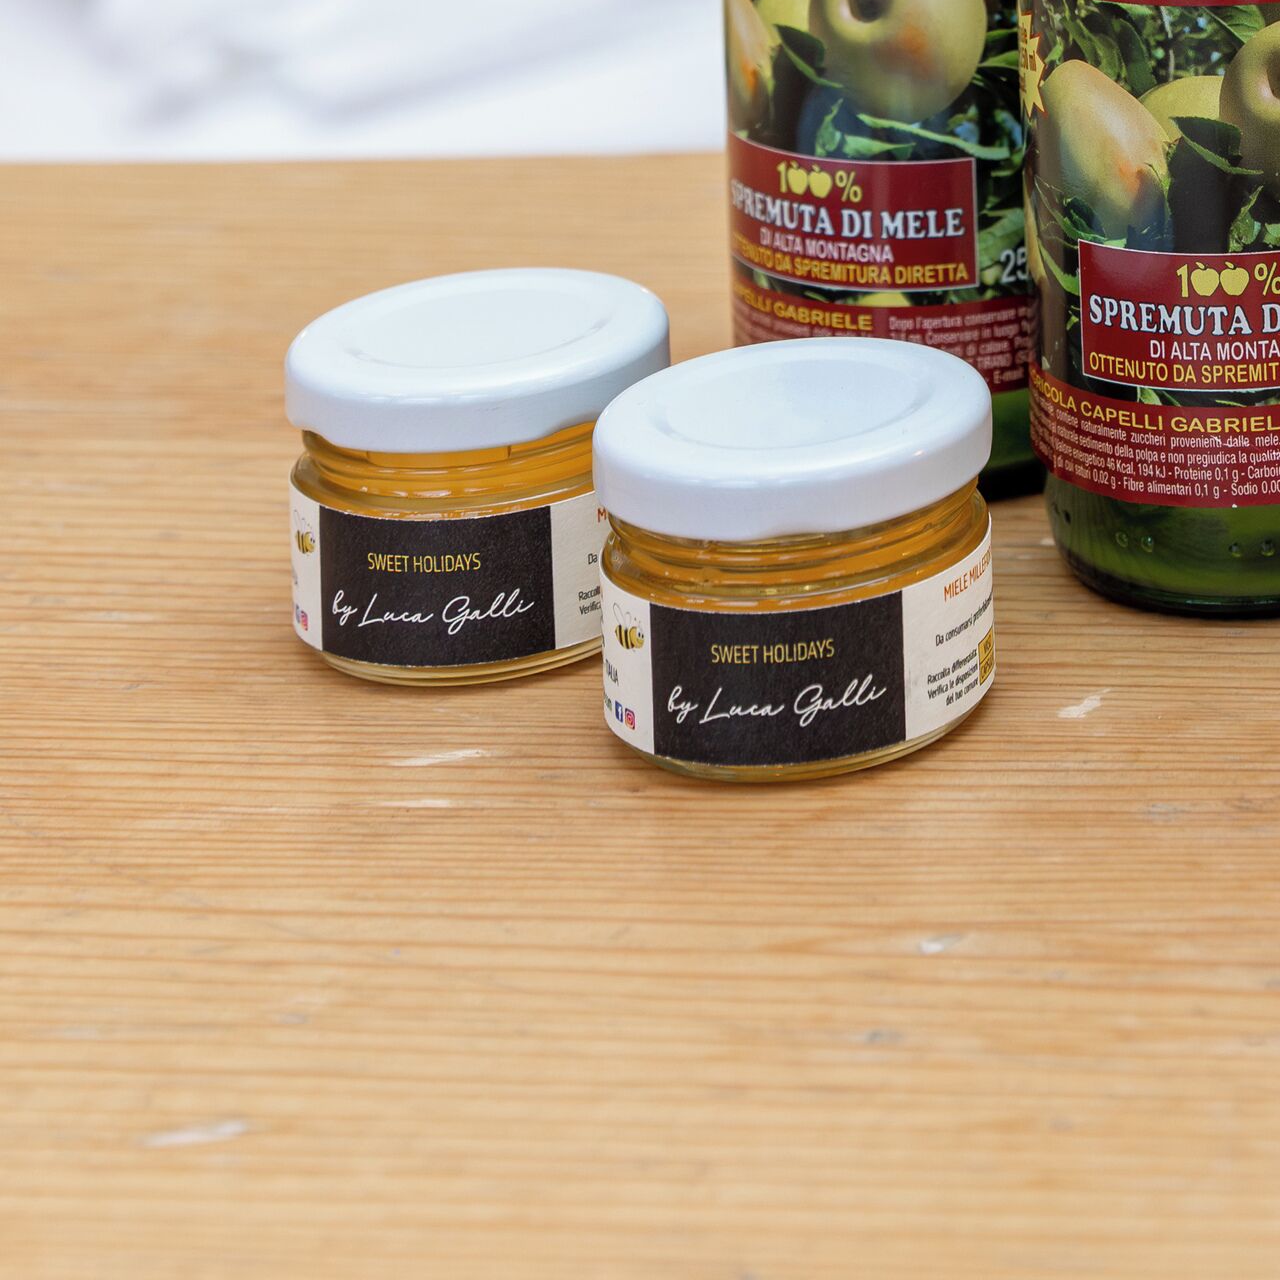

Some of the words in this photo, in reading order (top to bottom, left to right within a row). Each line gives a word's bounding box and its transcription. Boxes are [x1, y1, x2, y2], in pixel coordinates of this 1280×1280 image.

[731, 178, 835, 237] SPREMUTA
[840, 208, 874, 239] DI
[880, 207, 966, 240] MELE
[772, 229, 803, 256] ALTA
[804, 236, 894, 264] MONTAGNA
[774, 251, 793, 274] DA
[794, 255, 890, 285] SPREMITURA
[894, 262, 969, 285] DIRETTA
[773, 300, 873, 331] GABRIELE
[1089, 294, 1253, 336] SPREMUTA
[1150, 339, 1166, 360] DI
[1170, 340, 1212, 361] ALTA
[1089, 351, 1168, 382] OTTENUTO
[1173, 363, 1197, 383] DA
[1080, 401, 1164, 431] CAPELLI
[1081, 419, 1127, 441] naturalmente
[1130, 431, 1166, 447] zuccheri
[1170, 433, 1222, 449] provenienti
[1226, 434, 1250, 448] dalle
[1255, 433, 1280, 447] mele.
[1072, 445, 1105, 467] energetico
[1106, 457, 1116, 471] 46
[1138, 463, 1154, 477] 194
[1155, 467, 1167, 479] kJ
[1174, 466, 1213, 481] Proteine
[1231, 469, 1239, 483] g
[1079, 434, 1114, 458] sedimento
[1114, 443, 1134, 459] della
[1135, 448, 1158, 464] polpa
[1160, 452, 1167, 463] e
[1168, 451, 1185, 464] non
[1187, 451, 1237, 468] pregiudica
[1238, 450, 1248, 464] la
[1110, 475, 1117, 490] g
[1123, 477, 1144, 493] Fibre
[1147, 481, 1192, 497] alimentari
[1212, 485, 1220, 500] g
[1231, 482, 1258, 497] Sodio
[367, 552, 409, 573] SWEET
[413, 552, 481, 573] HOLIDAYS
[587, 552, 598, 565] Da
[943, 573, 969, 604] MIELE
[332, 590, 358, 626] by
[357, 592, 434, 628] Luca
[441, 587, 535, 635] Galli
[935, 634, 944, 647] Da
[945, 613, 973, 642] consumarsi
[711, 644, 759, 665] SWEET
[763, 638, 835, 664] HOLIDAYS
[927, 666, 951, 685] Raccolta
[927, 682, 949, 700] Verifica
[667, 685, 698, 724] by
[698, 686, 785, 725] Luca
[793, 673, 888, 728] Galli
[946, 692, 954, 707] del
